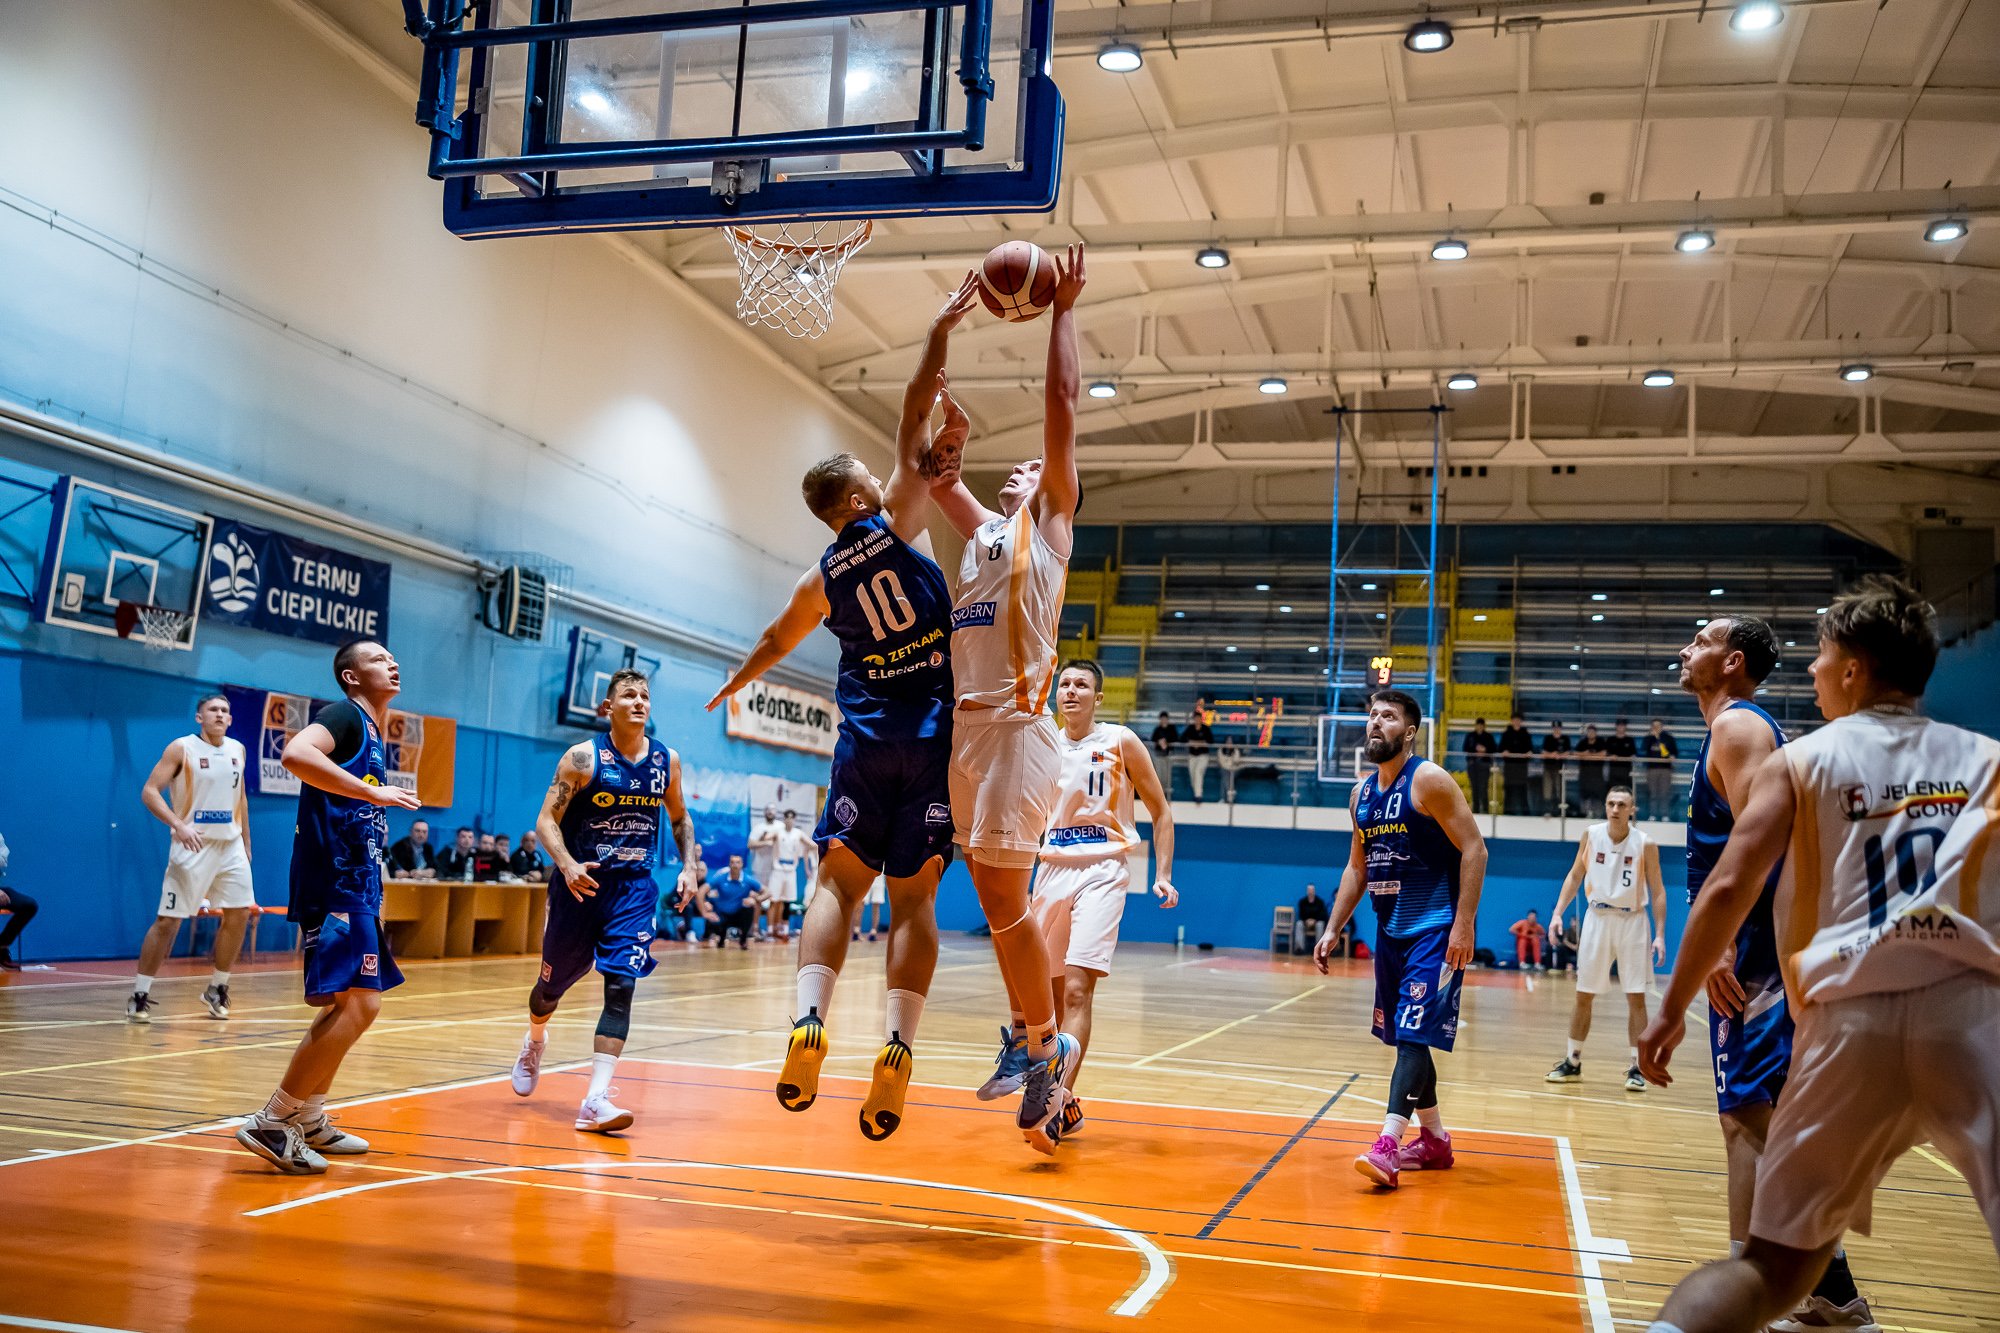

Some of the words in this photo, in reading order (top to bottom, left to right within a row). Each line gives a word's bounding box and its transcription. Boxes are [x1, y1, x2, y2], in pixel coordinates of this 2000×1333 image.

[827, 547, 855, 568] ZETKAMA
[854, 540, 864, 551] LA
[988, 535, 1006, 561] 6
[292, 556, 361, 598] TERMY
[829, 562, 851, 579] DORAL
[849, 552, 867, 567] NYSA
[267, 587, 379, 636] CIEPLICKIE
[856, 569, 917, 642] 10
[1378, 668, 1390, 684] 9
[262, 764, 297, 782] SUDE
[650, 767, 666, 794] 21
[1088, 770, 1104, 797] 11
[1881, 780, 1969, 801] JELENIA
[1385, 792, 1403, 820] 13
[1057, 826, 1106, 840] MODERN
[1622, 870, 1632, 888] 5
[1864, 826, 1947, 930] 10
[165, 891, 177, 910] 3
[628, 944, 648, 972] 21
[1400, 1004, 1425, 1030] 13
[1716, 1052, 1728, 1093] 5
